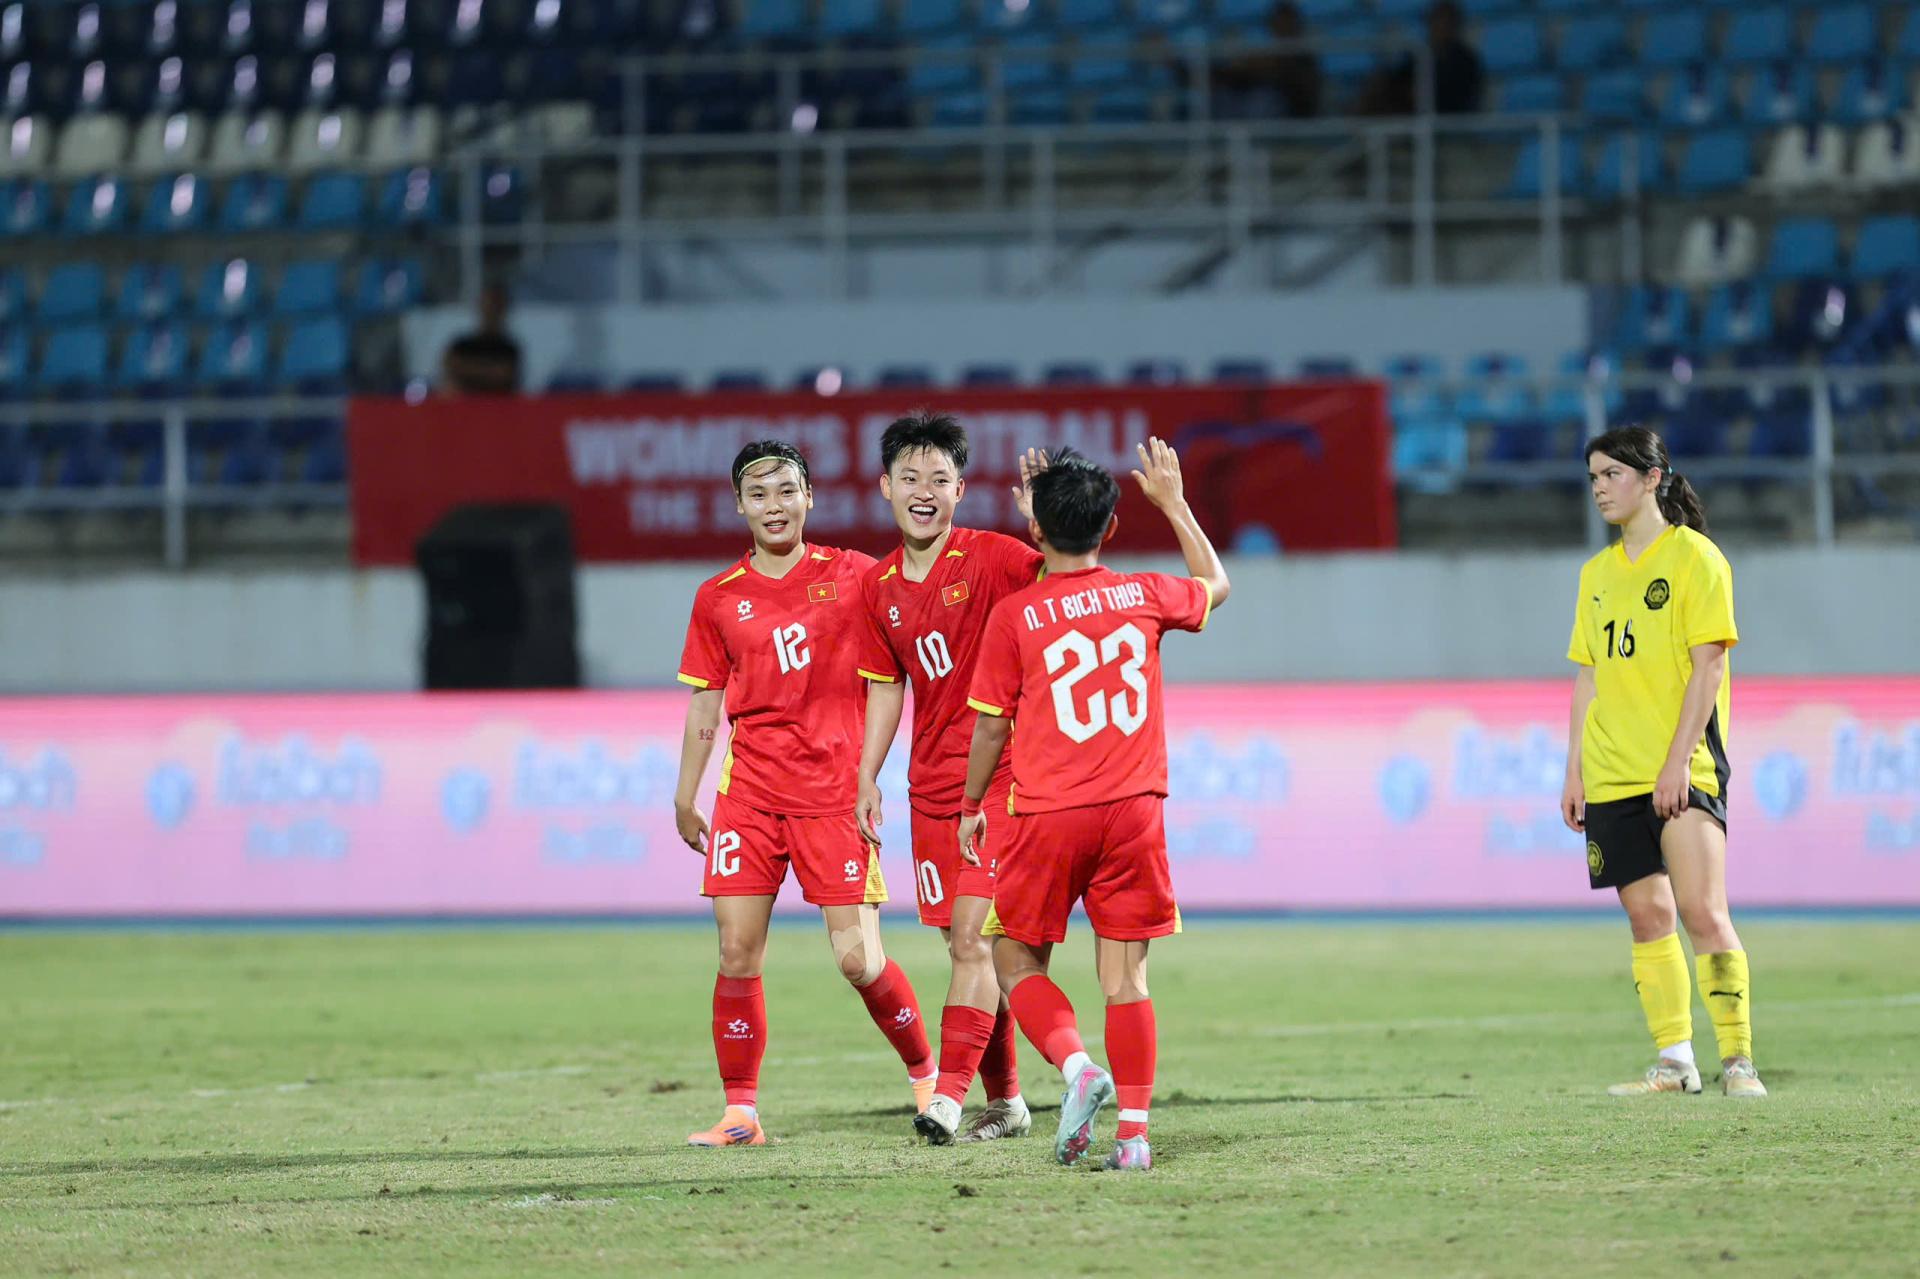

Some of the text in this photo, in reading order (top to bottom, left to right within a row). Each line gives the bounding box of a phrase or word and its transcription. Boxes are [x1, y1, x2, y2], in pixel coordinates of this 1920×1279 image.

[1043, 598, 1057, 624] T
[1061, 588, 1103, 621] BICH
[1091, 582, 1145, 612] THUY
[772, 622, 811, 675] 12
[915, 630, 954, 681] 10
[1603, 618, 1636, 659] 16
[1043, 621, 1148, 744] 23
[711, 829, 741, 877] 12
[915, 858, 944, 906] 10
